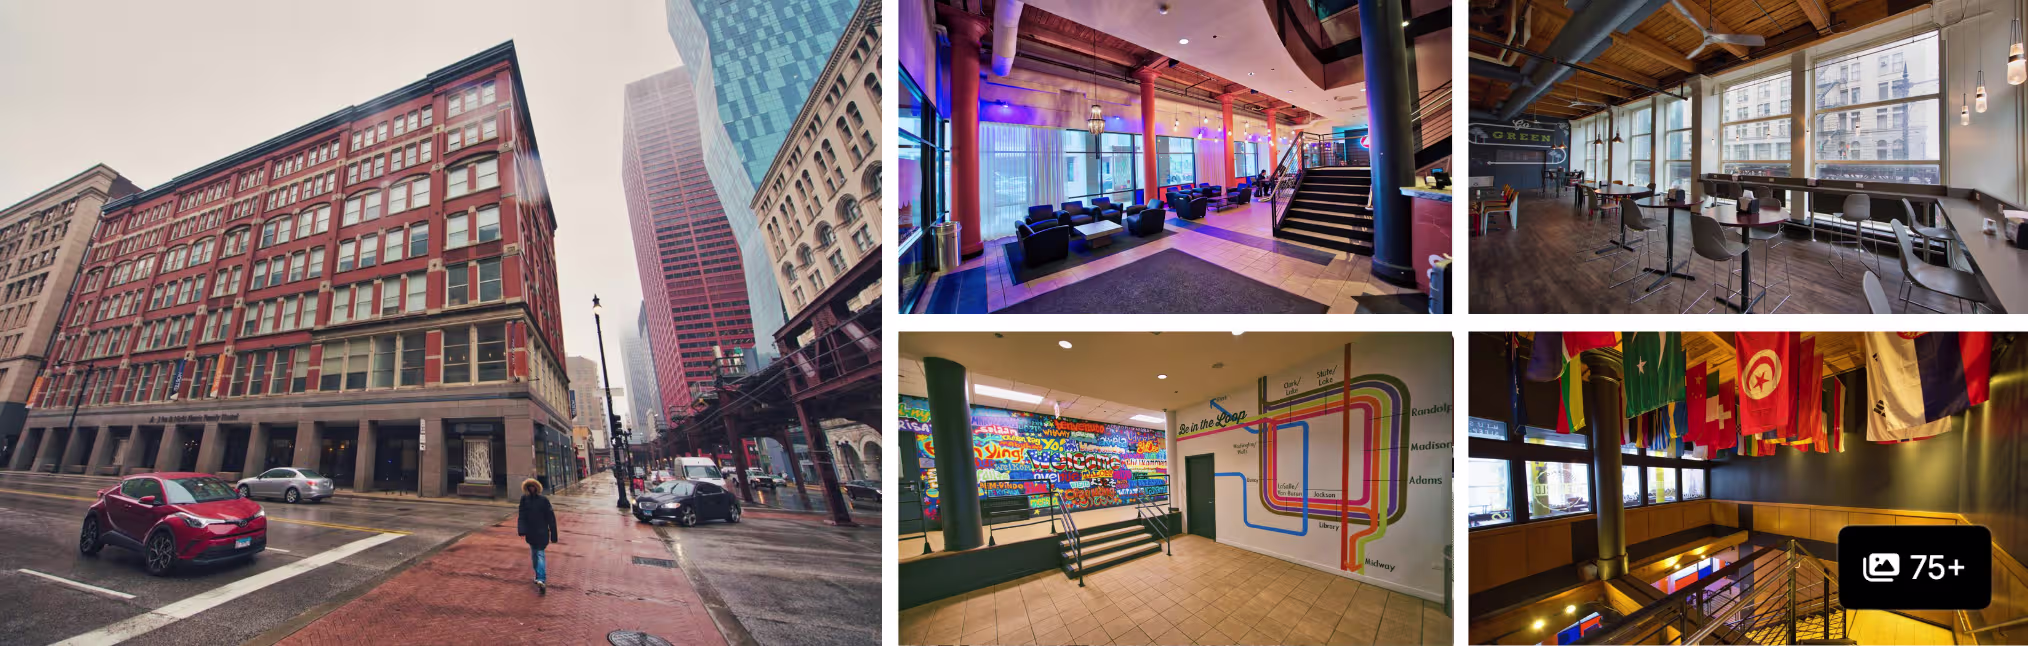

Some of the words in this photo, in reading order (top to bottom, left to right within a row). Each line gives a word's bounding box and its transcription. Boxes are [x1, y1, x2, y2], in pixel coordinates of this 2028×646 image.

[1512, 120, 1531, 130] Go
[1492, 131, 1551, 142] GREEN
[1318, 377, 1333, 386] Lake
[1178, 423, 1190, 435] Be
[1191, 422, 1200, 432] in
[1200, 418, 1214, 429] the
[1215, 410, 1248, 428] Loop
[1040, 438, 1066, 452] Yo!
[1410, 441, 1453, 451] Madison
[984, 442, 1025, 463] Ying!
[1408, 475, 1443, 484] Adams
[1318, 521, 1340, 531] Library
[1365, 557, 1396, 572] Midway
